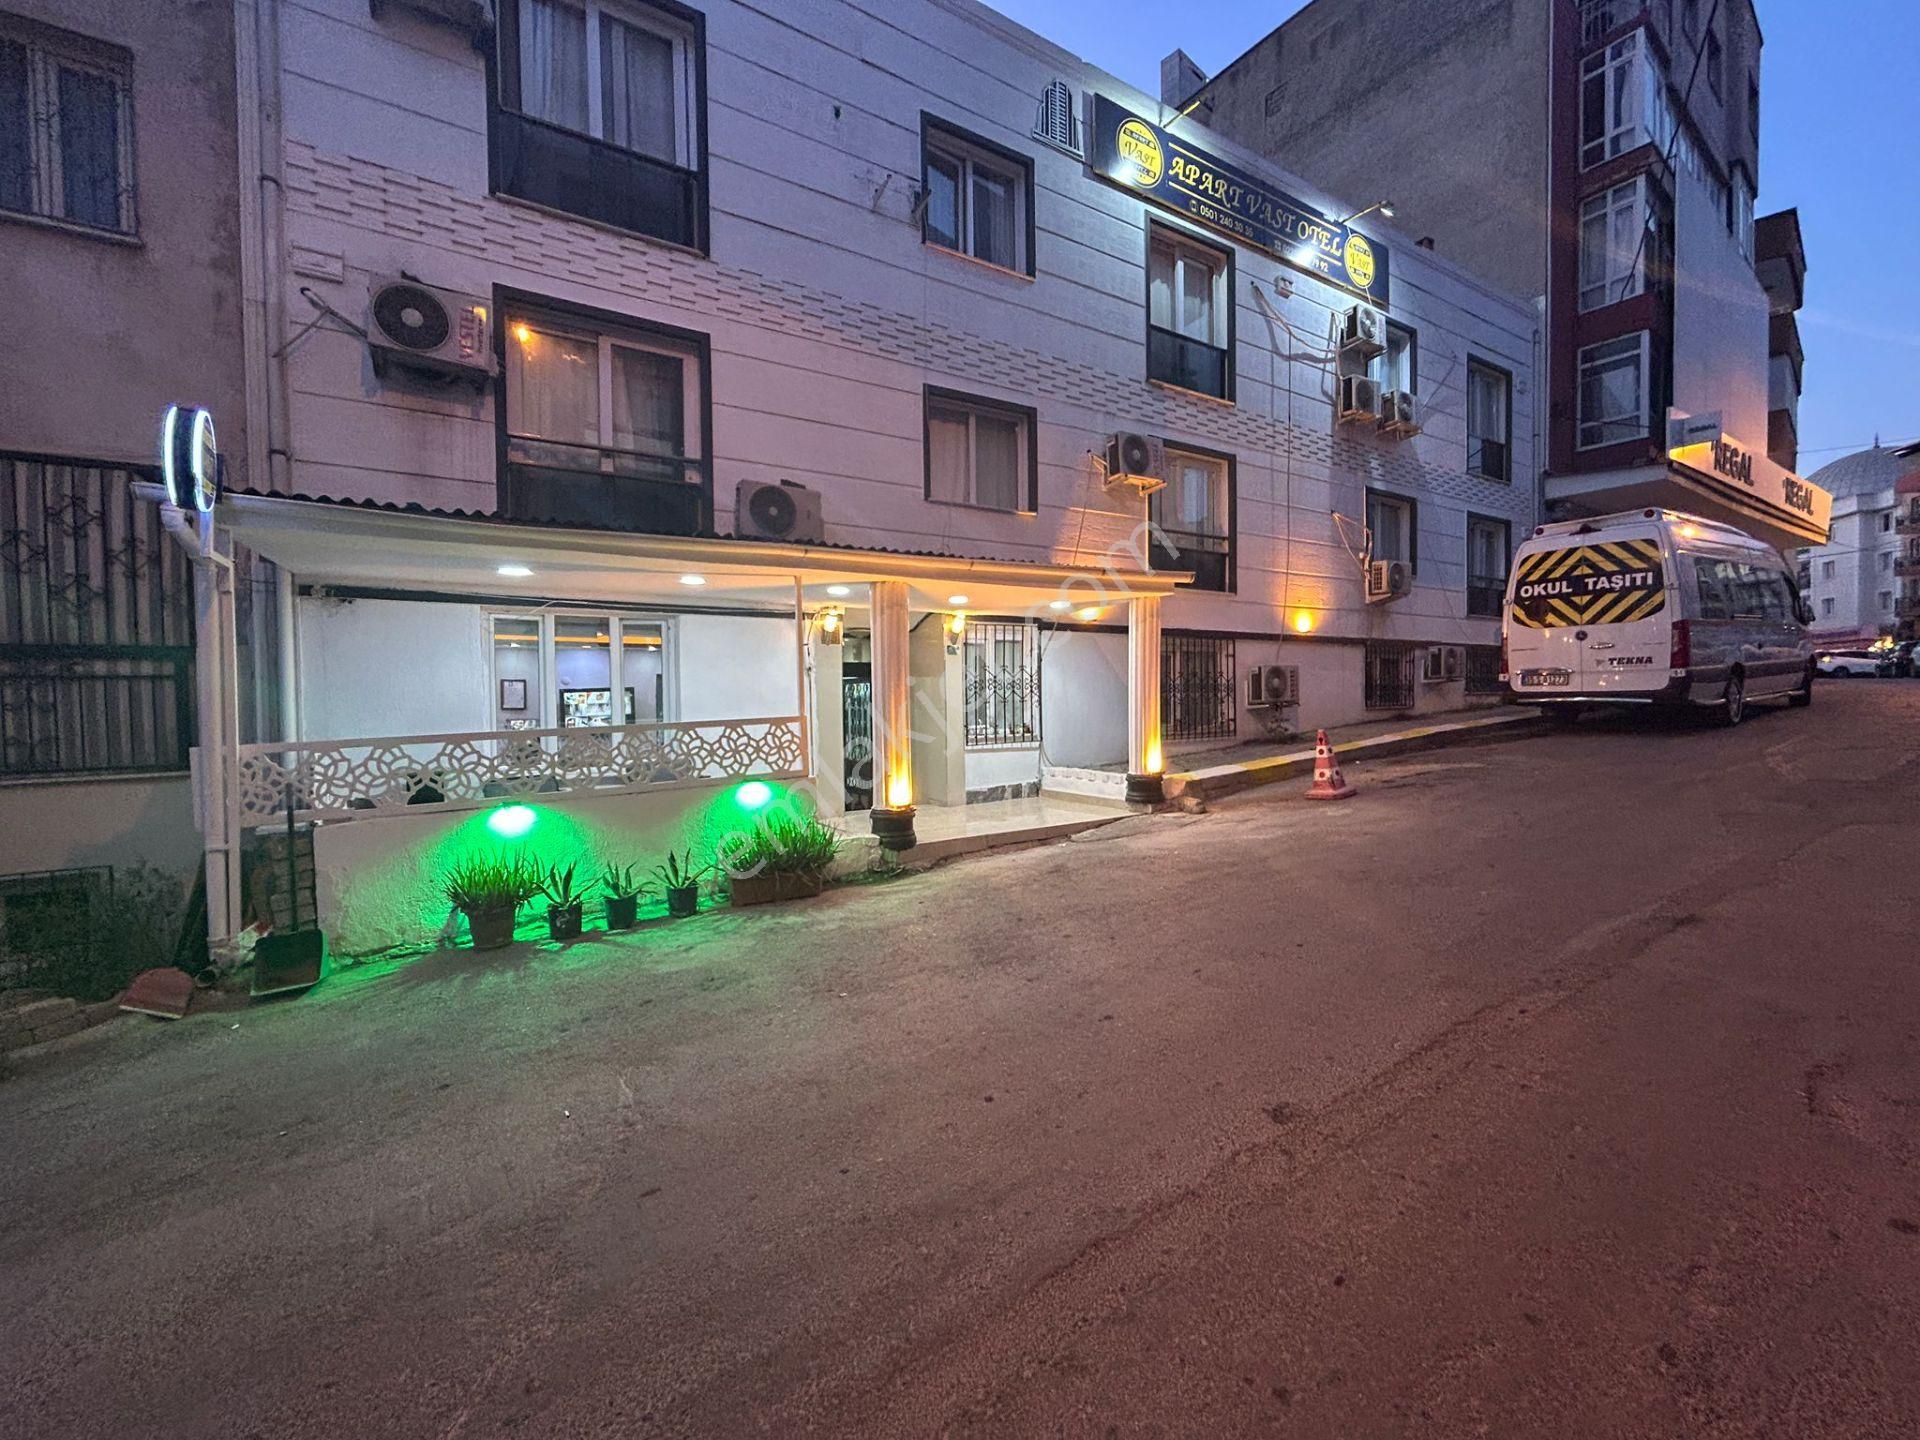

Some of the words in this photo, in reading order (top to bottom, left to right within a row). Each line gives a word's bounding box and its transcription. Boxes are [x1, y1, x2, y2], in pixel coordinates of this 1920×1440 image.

[1168, 156, 1244, 208] APART
[1246, 193, 1297, 233] VAST
[1297, 221, 1342, 257] OTEL
[1200, 204, 1217, 222] 0501
[1520, 580, 1573, 598] OKUL
[1584, 572, 1654, 591] TAŞITI
[1608, 656, 1654, 666] TEKNA
